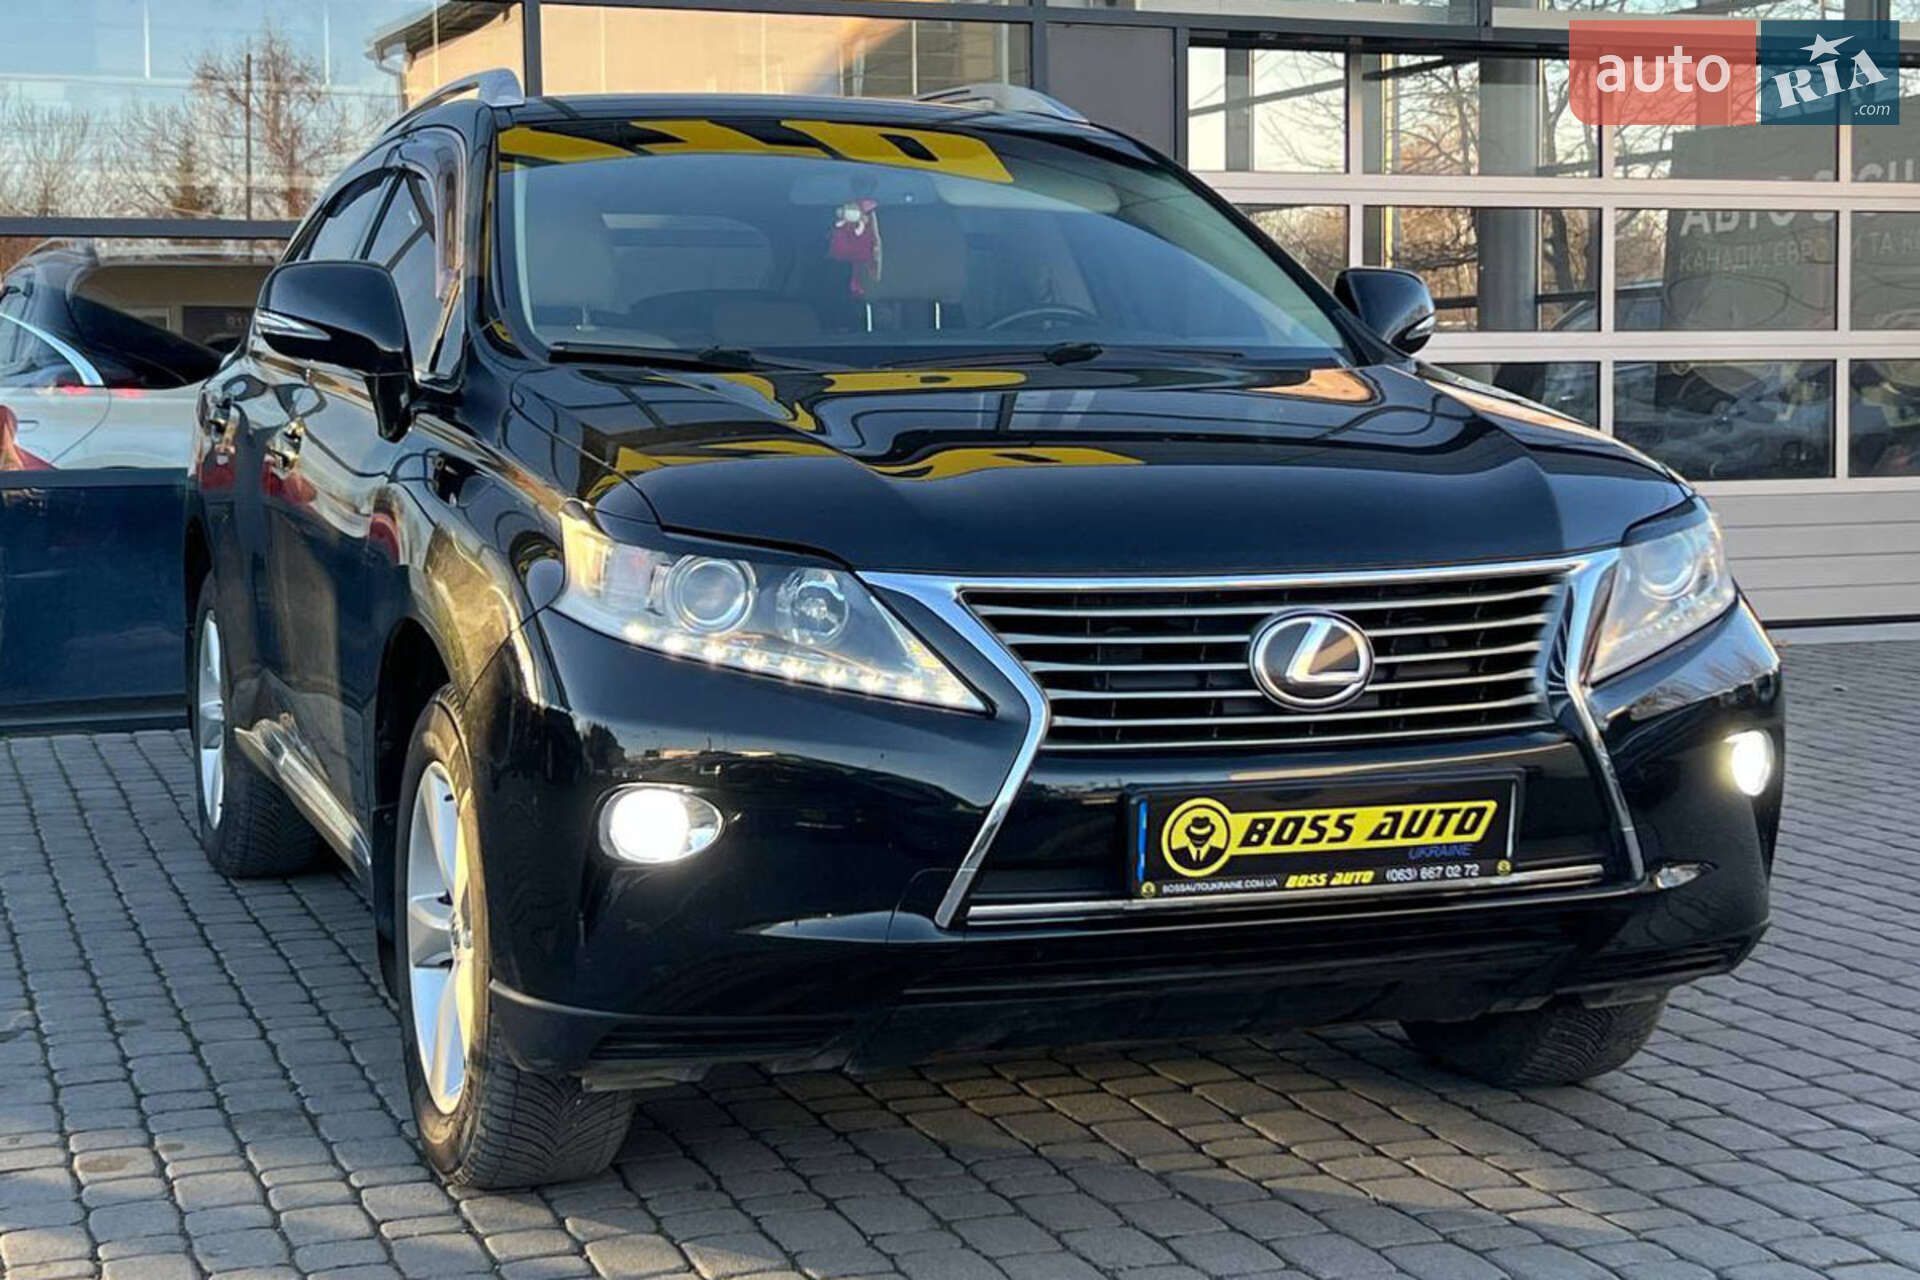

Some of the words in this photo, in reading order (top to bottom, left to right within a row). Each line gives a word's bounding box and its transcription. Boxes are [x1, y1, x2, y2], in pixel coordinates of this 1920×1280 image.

[1239, 813, 1355, 848] BOSS
[1367, 806, 1488, 841] AUTO
[1408, 844, 1472, 859] UKRAINE
[1285, 873, 1328, 888] BOSS
[1330, 870, 1375, 886] AUTO
[1386, 866, 1417, 882] (063)
[1420, 865, 1442, 880] 667
[1445, 865, 1461, 879] 02
[1464, 863, 1479, 876] 72
